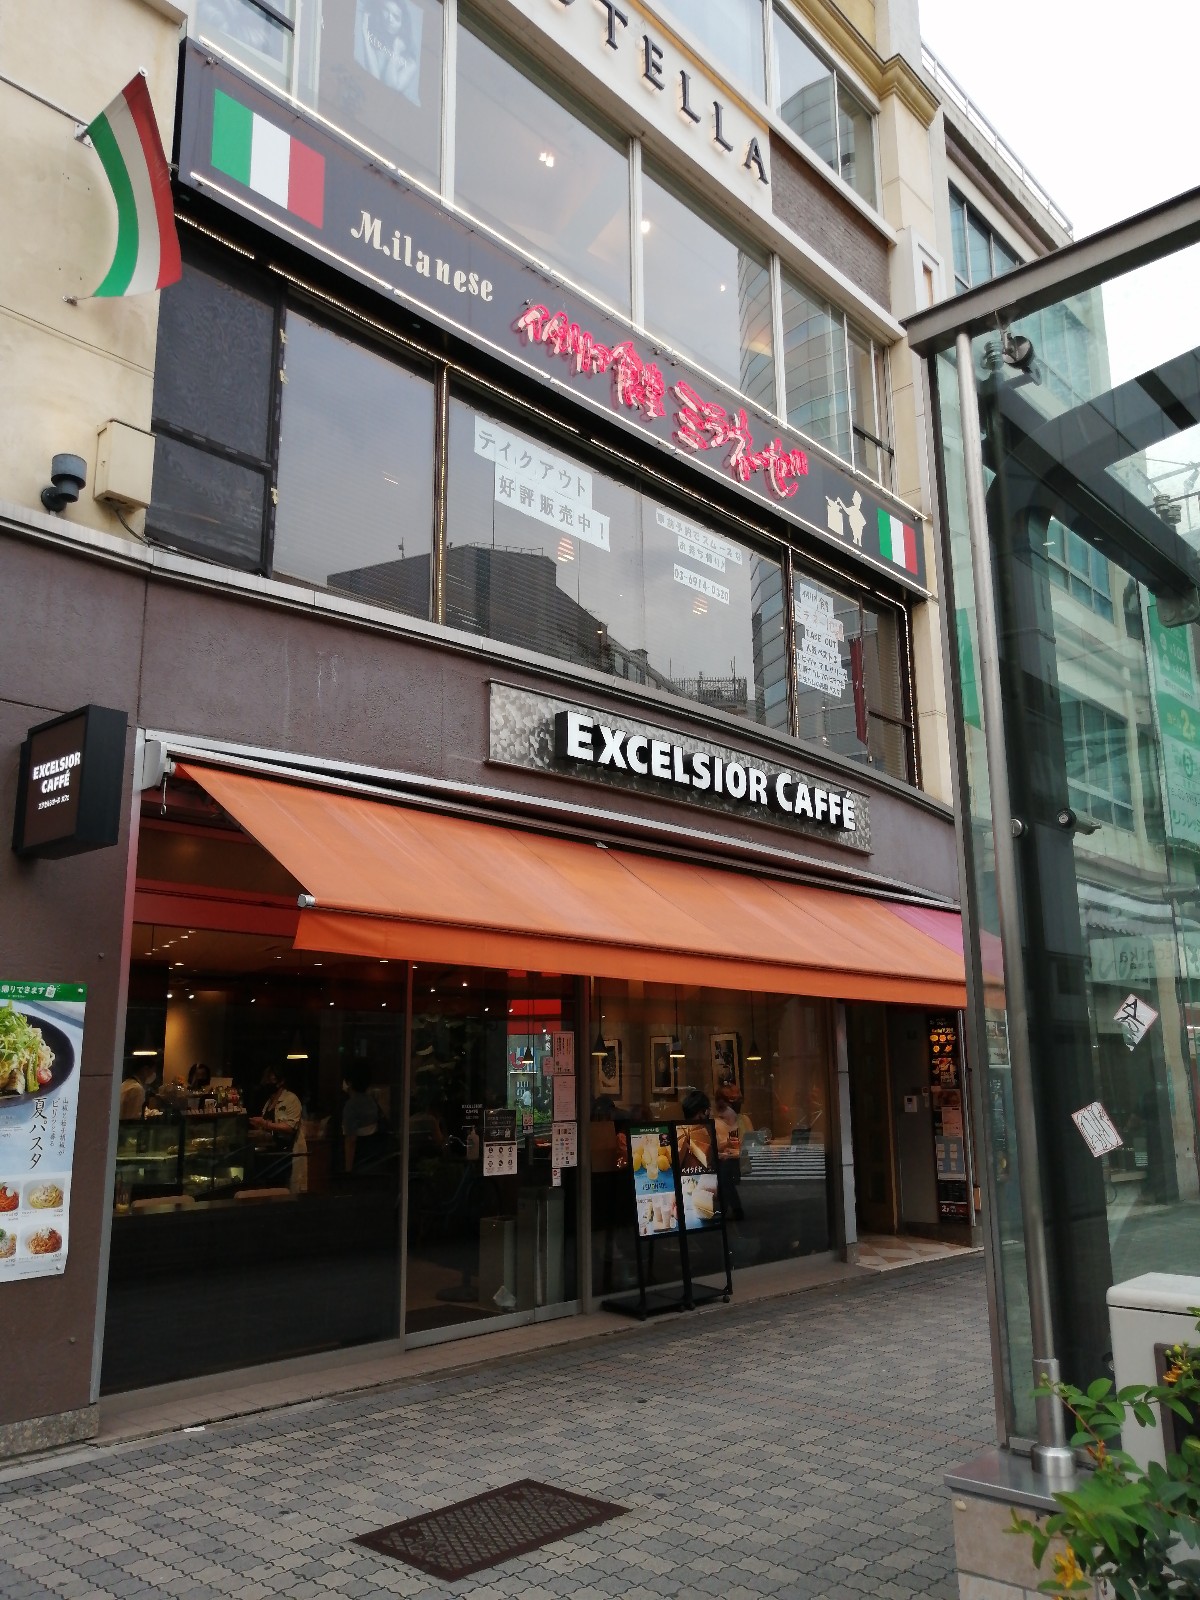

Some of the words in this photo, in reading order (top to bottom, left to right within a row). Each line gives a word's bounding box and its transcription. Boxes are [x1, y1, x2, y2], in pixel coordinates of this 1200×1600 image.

[553, 0, 769, 185] TELLA
[478, 429, 587, 498] テイクアウト
[498, 474, 604, 540] 好評販売中!
[674, 568, 729, 601] 03-6914-0320
[824, 636, 836, 649] OUT
[32, 751, 81, 780] EXCELSIOR
[41, 769, 71, 794] CAFFÉ
[556, 710, 768, 806] EXCELSIOR
[774, 771, 857, 832] CAFFÉ
[0, 984, 46, 995] 帰りできます
[29, 1097, 48, 1170] 夏パスタ
